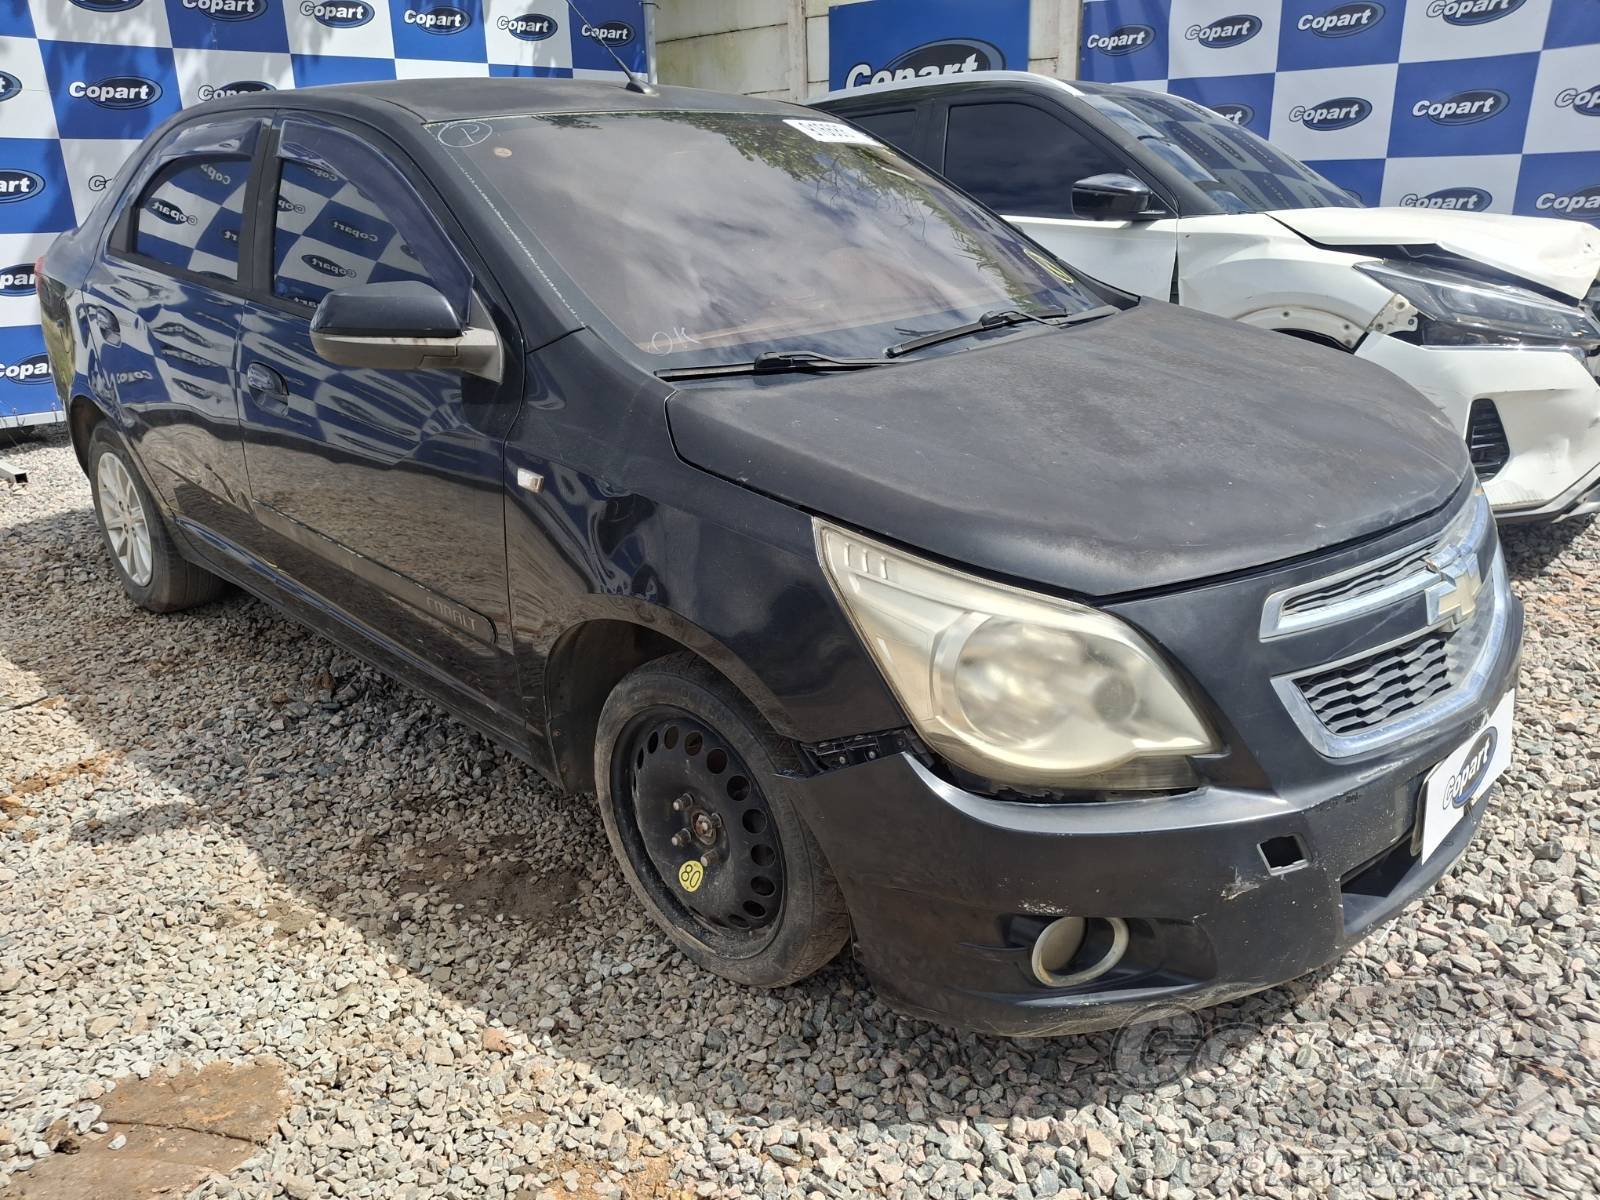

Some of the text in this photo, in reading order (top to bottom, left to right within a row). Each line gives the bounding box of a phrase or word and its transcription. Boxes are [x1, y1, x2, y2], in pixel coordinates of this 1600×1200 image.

[300, 2, 364, 20] Copart
[404, 9, 462, 28] Copart
[497, 16, 549, 35] Copart
[1185, 22, 1250, 41] Copart
[1297, 11, 1372, 33] Copart
[581, 24, 628, 41] Copart
[1087, 31, 1146, 49] Copart
[69, 81, 149, 102] Copart
[1289, 103, 1359, 123] Copart
[1412, 97, 1495, 118] Copart
[1400, 194, 1479, 209] Copart
[1443, 736, 1491, 811] Copart
[681, 864, 700, 888] 80
